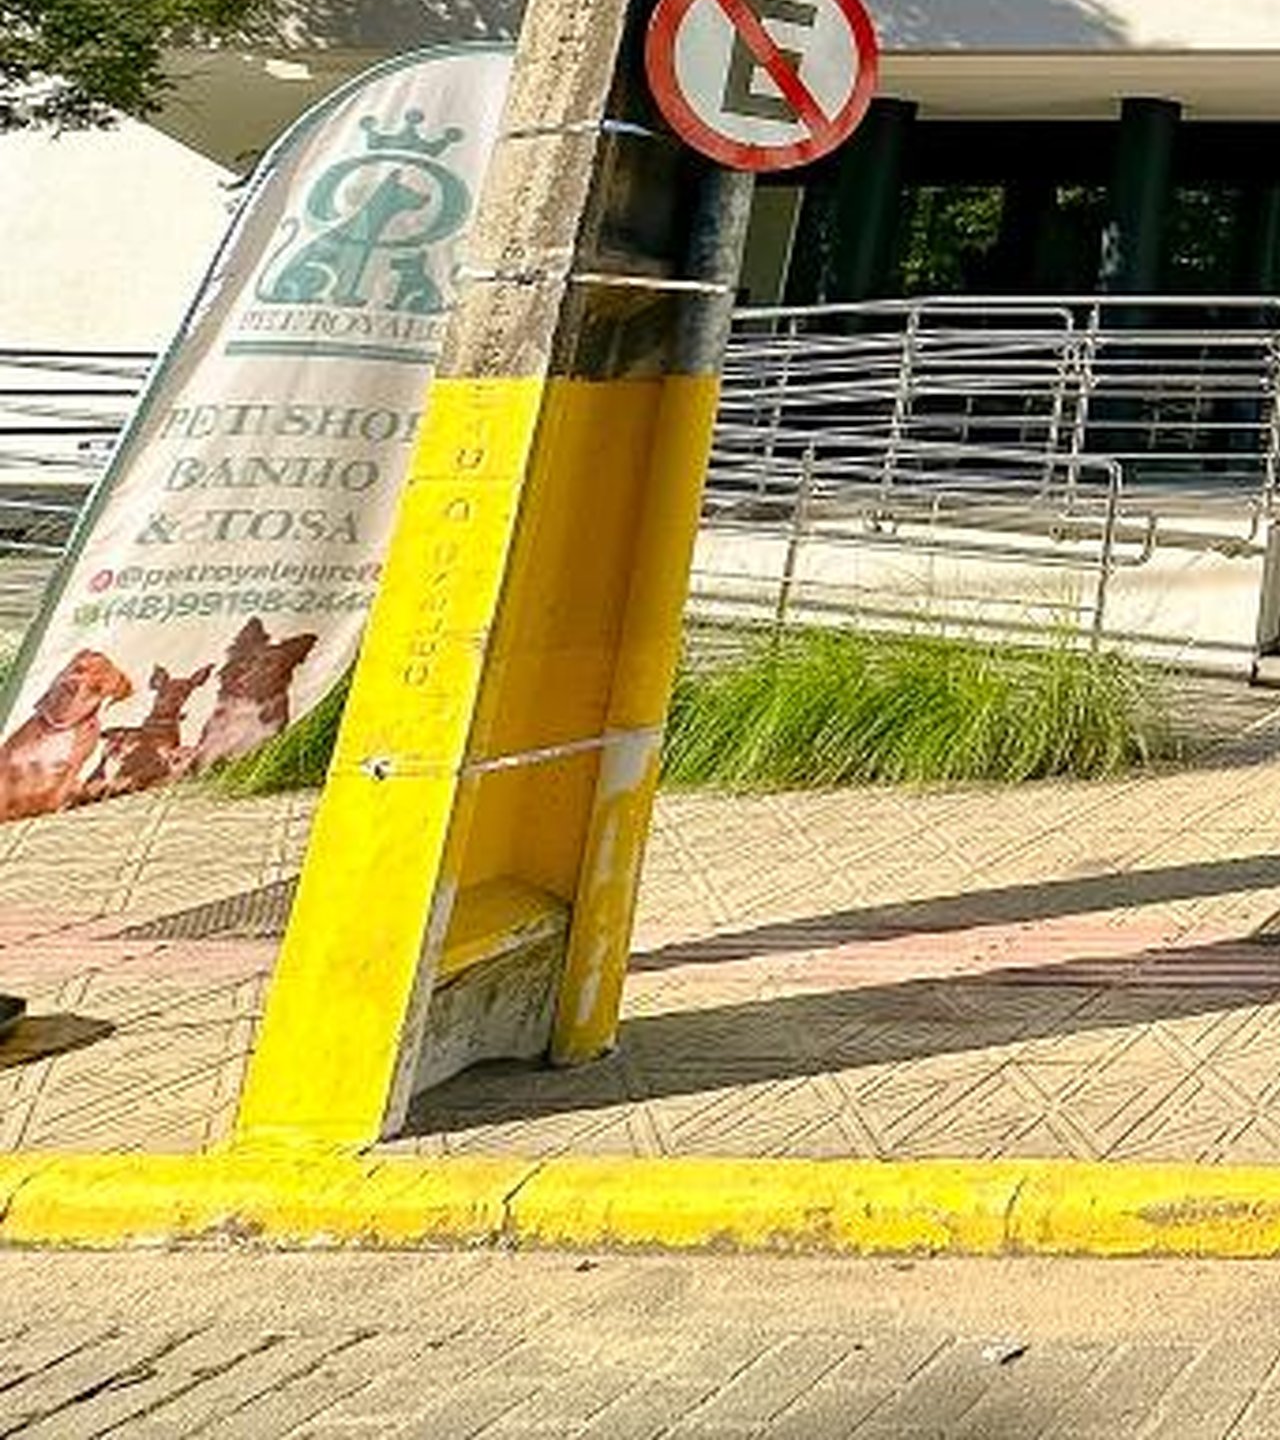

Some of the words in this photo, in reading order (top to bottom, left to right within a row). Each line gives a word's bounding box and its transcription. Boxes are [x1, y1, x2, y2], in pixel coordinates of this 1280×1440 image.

[160, 404, 272, 440] PET
[165, 456, 379, 492] BANHO
[206, 509, 360, 544] TOSA
